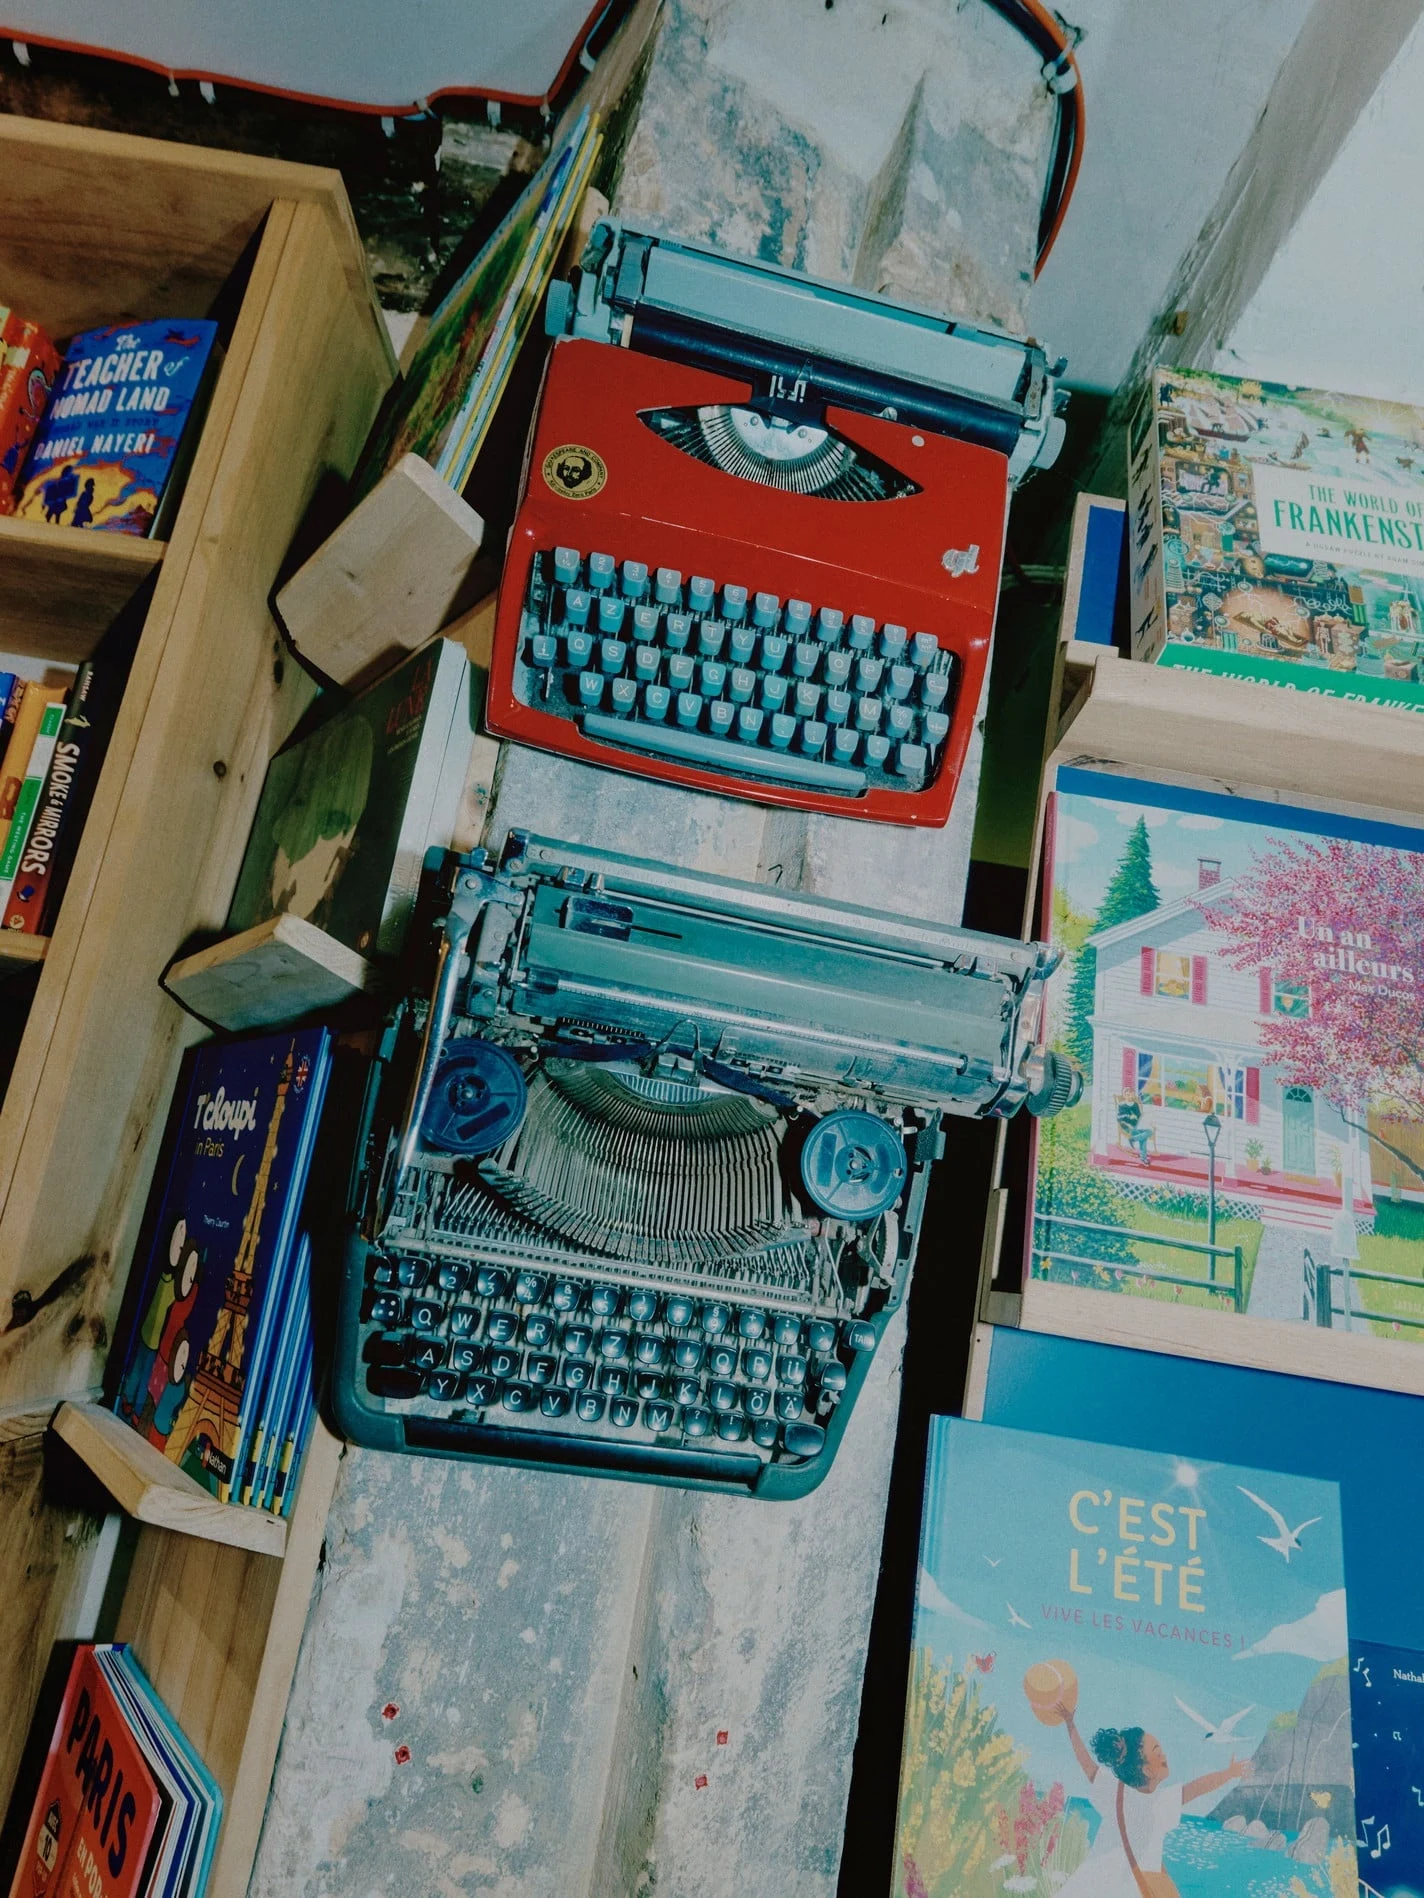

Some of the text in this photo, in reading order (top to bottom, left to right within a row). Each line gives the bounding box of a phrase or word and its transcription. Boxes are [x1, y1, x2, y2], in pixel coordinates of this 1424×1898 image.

[62, 350, 164, 391] TEACHER
[49, 388, 113, 420] NOMAD
[115, 386, 170, 412] LAND
[34, 432, 155, 461] DANIEL NAYERI
[1308, 484, 1424, 518] THE WORLD OF
[1273, 499, 1424, 551] FRANKENST
[20, 741, 81, 876] SMOKE & MIRRORS
[1298, 915, 1372, 949] Un an
[1313, 946, 1414, 983] ailleurs
[203, 1137, 225, 1157] Paris
[1069, 1488, 1207, 1552] C'EST
[1069, 1545, 1207, 1613] L'ÉTÉ
[1041, 1604, 1083, 1626] VIVE
[1092, 1612, 1124, 1632] LES
[1132, 1618, 1233, 1649] VACANCES
[66, 1688, 136, 1879] PARIS
